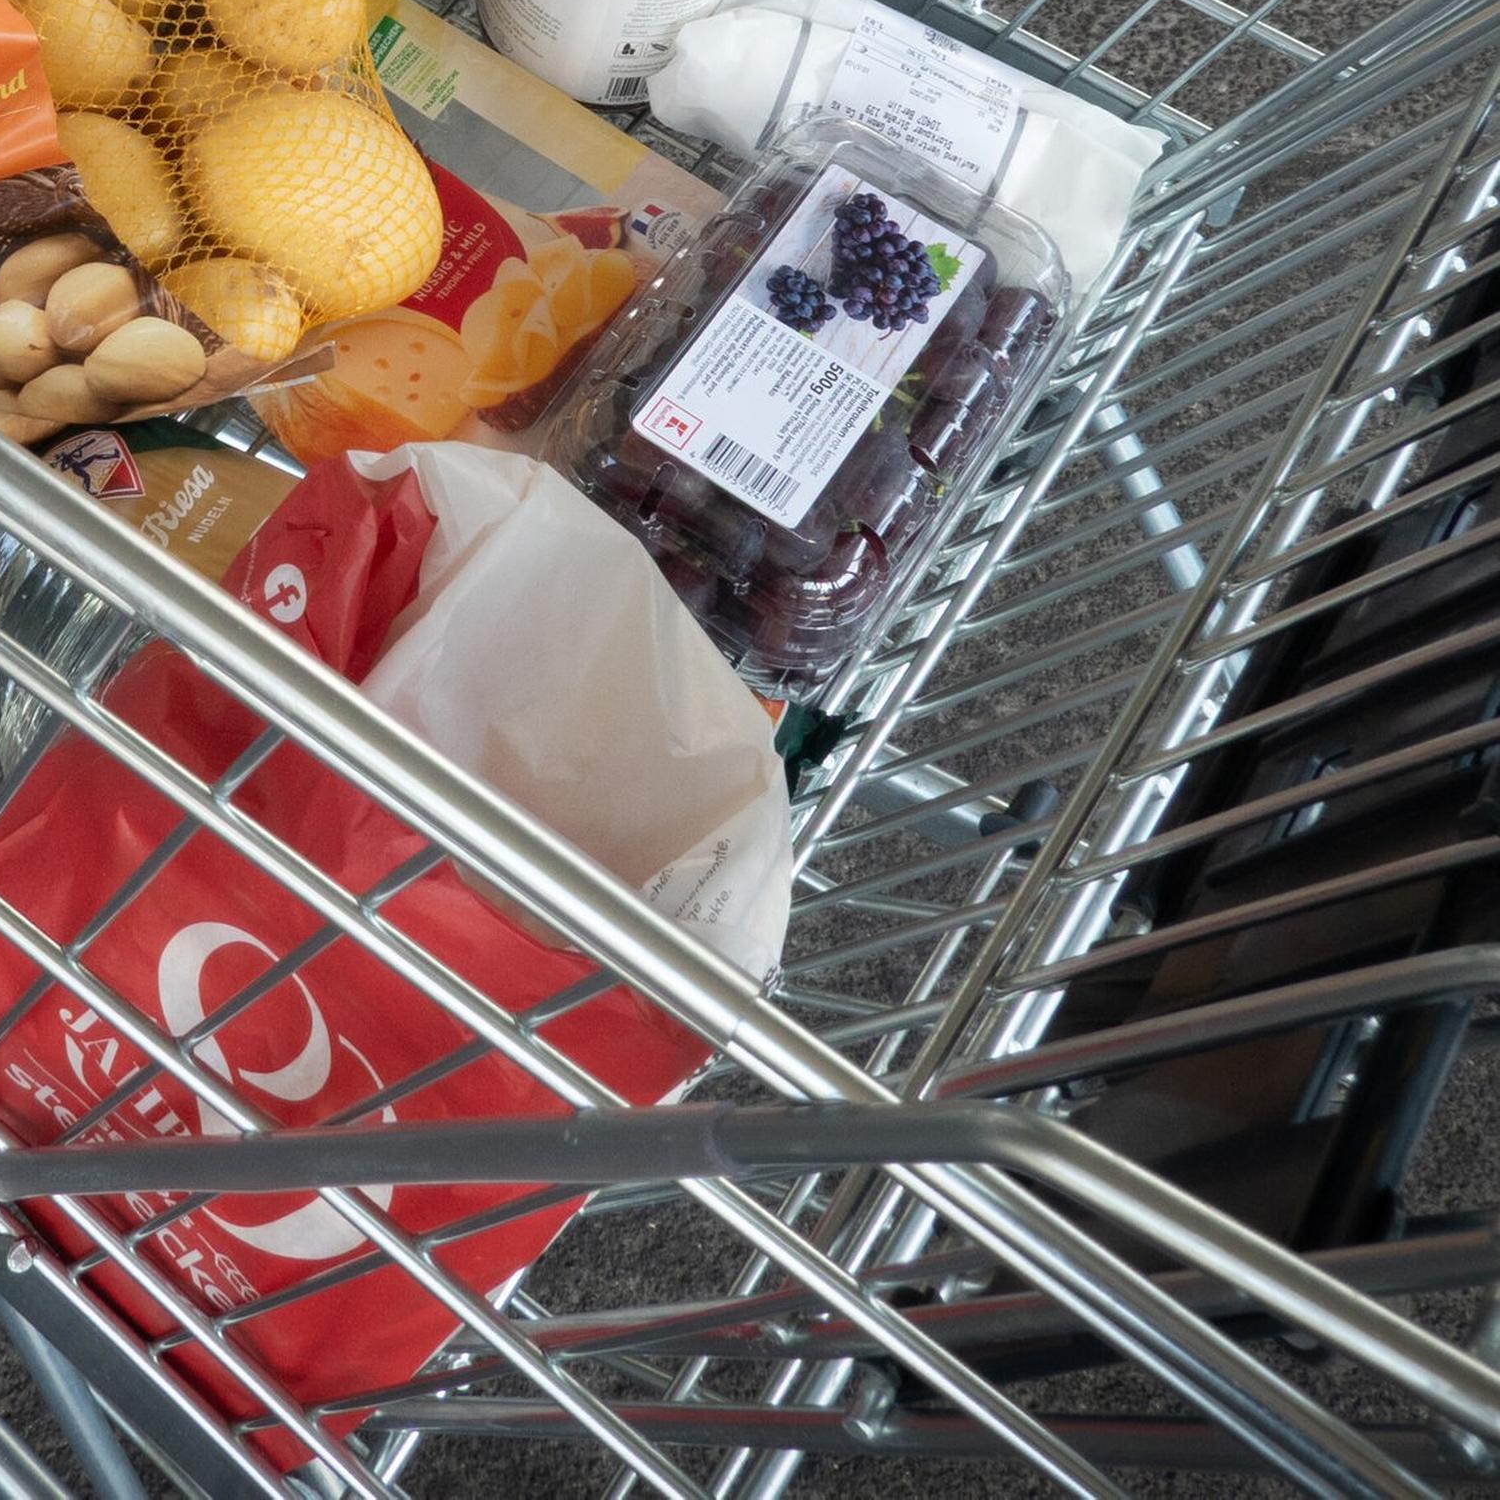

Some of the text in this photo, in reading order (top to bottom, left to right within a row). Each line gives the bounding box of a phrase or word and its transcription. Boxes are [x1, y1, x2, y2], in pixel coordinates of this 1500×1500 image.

[885, 97, 917, 121] Berlin
[941, 147, 981, 175] Kaufland
[450, 245, 465, 262] &
[460, 221, 488, 253] MILD
[766, 365, 793, 399] Marokko
[807, 356, 845, 400] 500g
[836, 383, 880, 442] Tafeltrauben
[828, 435, 844, 452] rot
[140, 461, 215, 550] Riesa
[187, 496, 234, 545] NUDELN
[4, 1061, 235, 1314] steiecke
